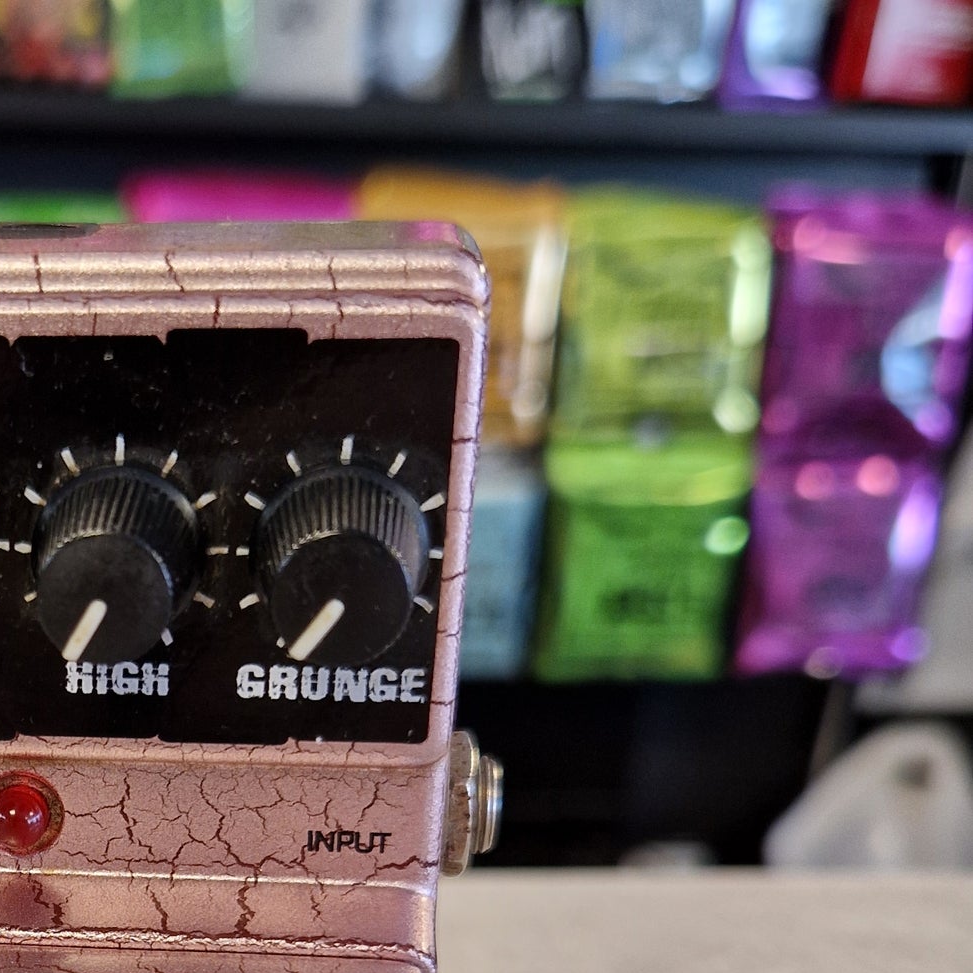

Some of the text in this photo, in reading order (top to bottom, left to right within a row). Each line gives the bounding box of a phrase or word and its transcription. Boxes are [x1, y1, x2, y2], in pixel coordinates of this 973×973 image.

[65, 661, 170, 696] HIGH
[236, 663, 426, 703] GRUNGE
[306, 830, 392, 855] INPUT
